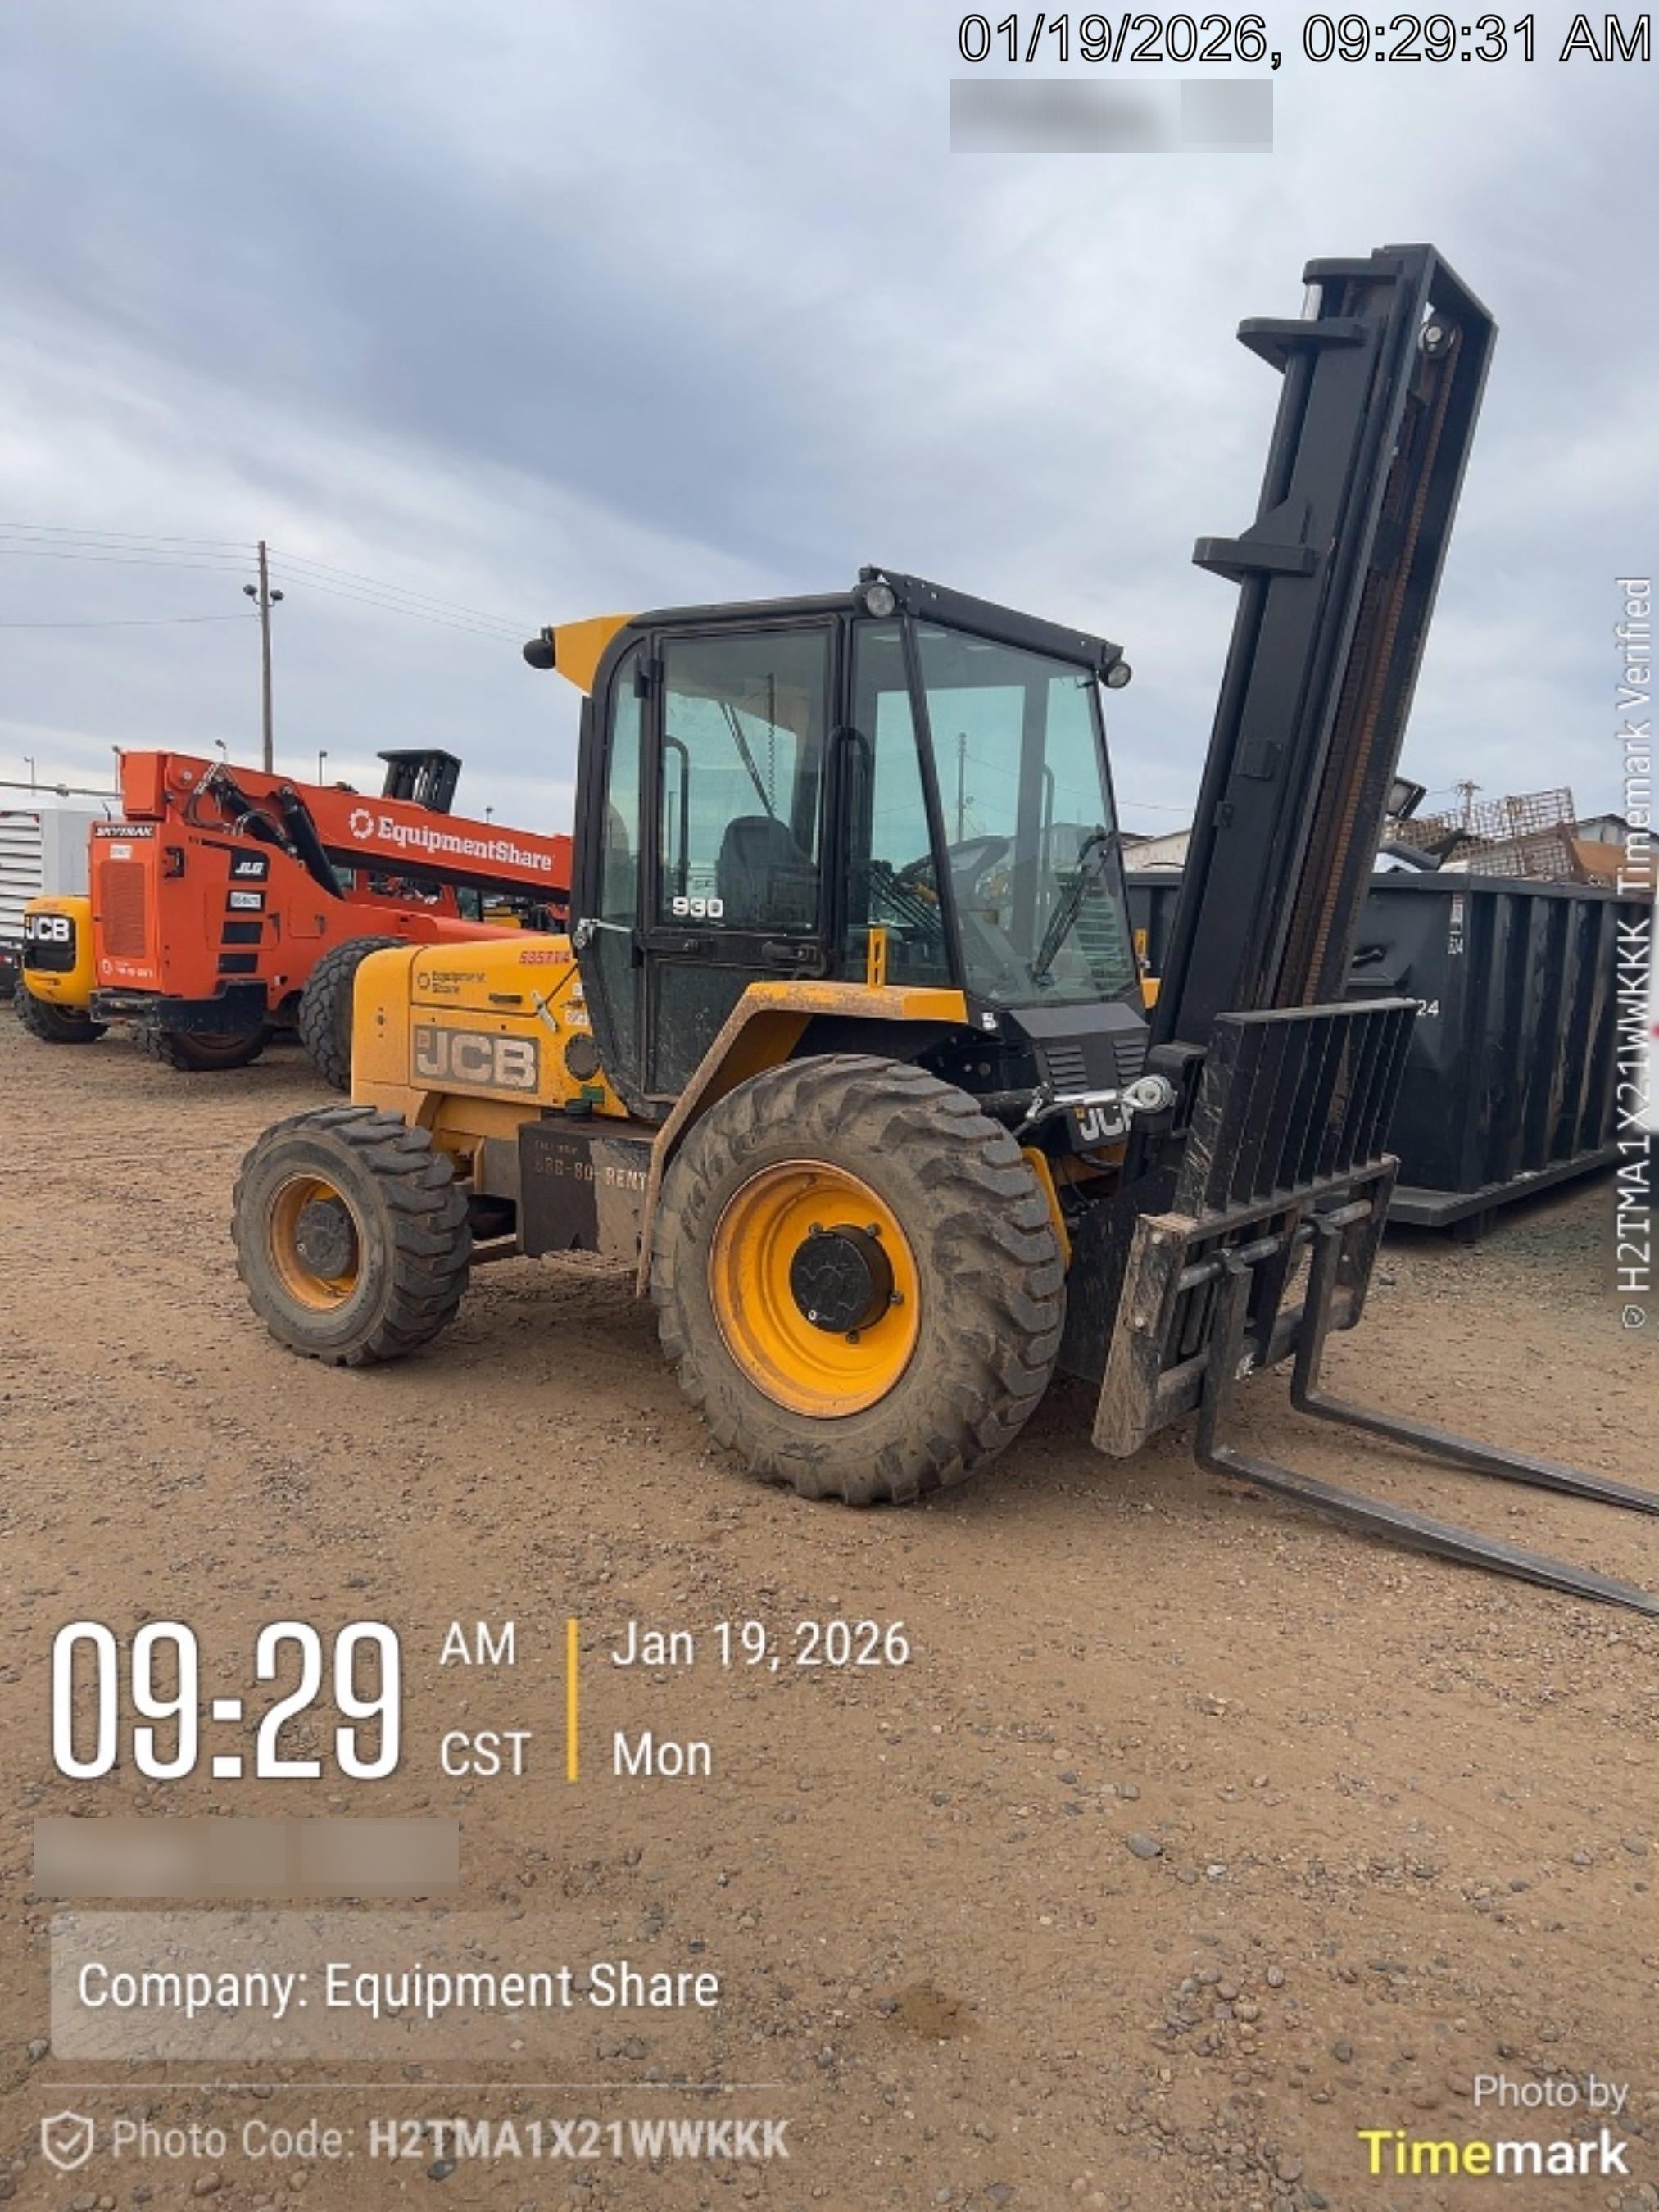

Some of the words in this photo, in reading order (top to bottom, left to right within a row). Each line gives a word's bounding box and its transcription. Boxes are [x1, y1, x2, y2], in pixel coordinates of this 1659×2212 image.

[378, 816, 552, 872] EquipmentShare
[235, 862, 264, 876] JLG
[25, 915, 69, 941] JCB
[417, 1029, 537, 1088] JCB
